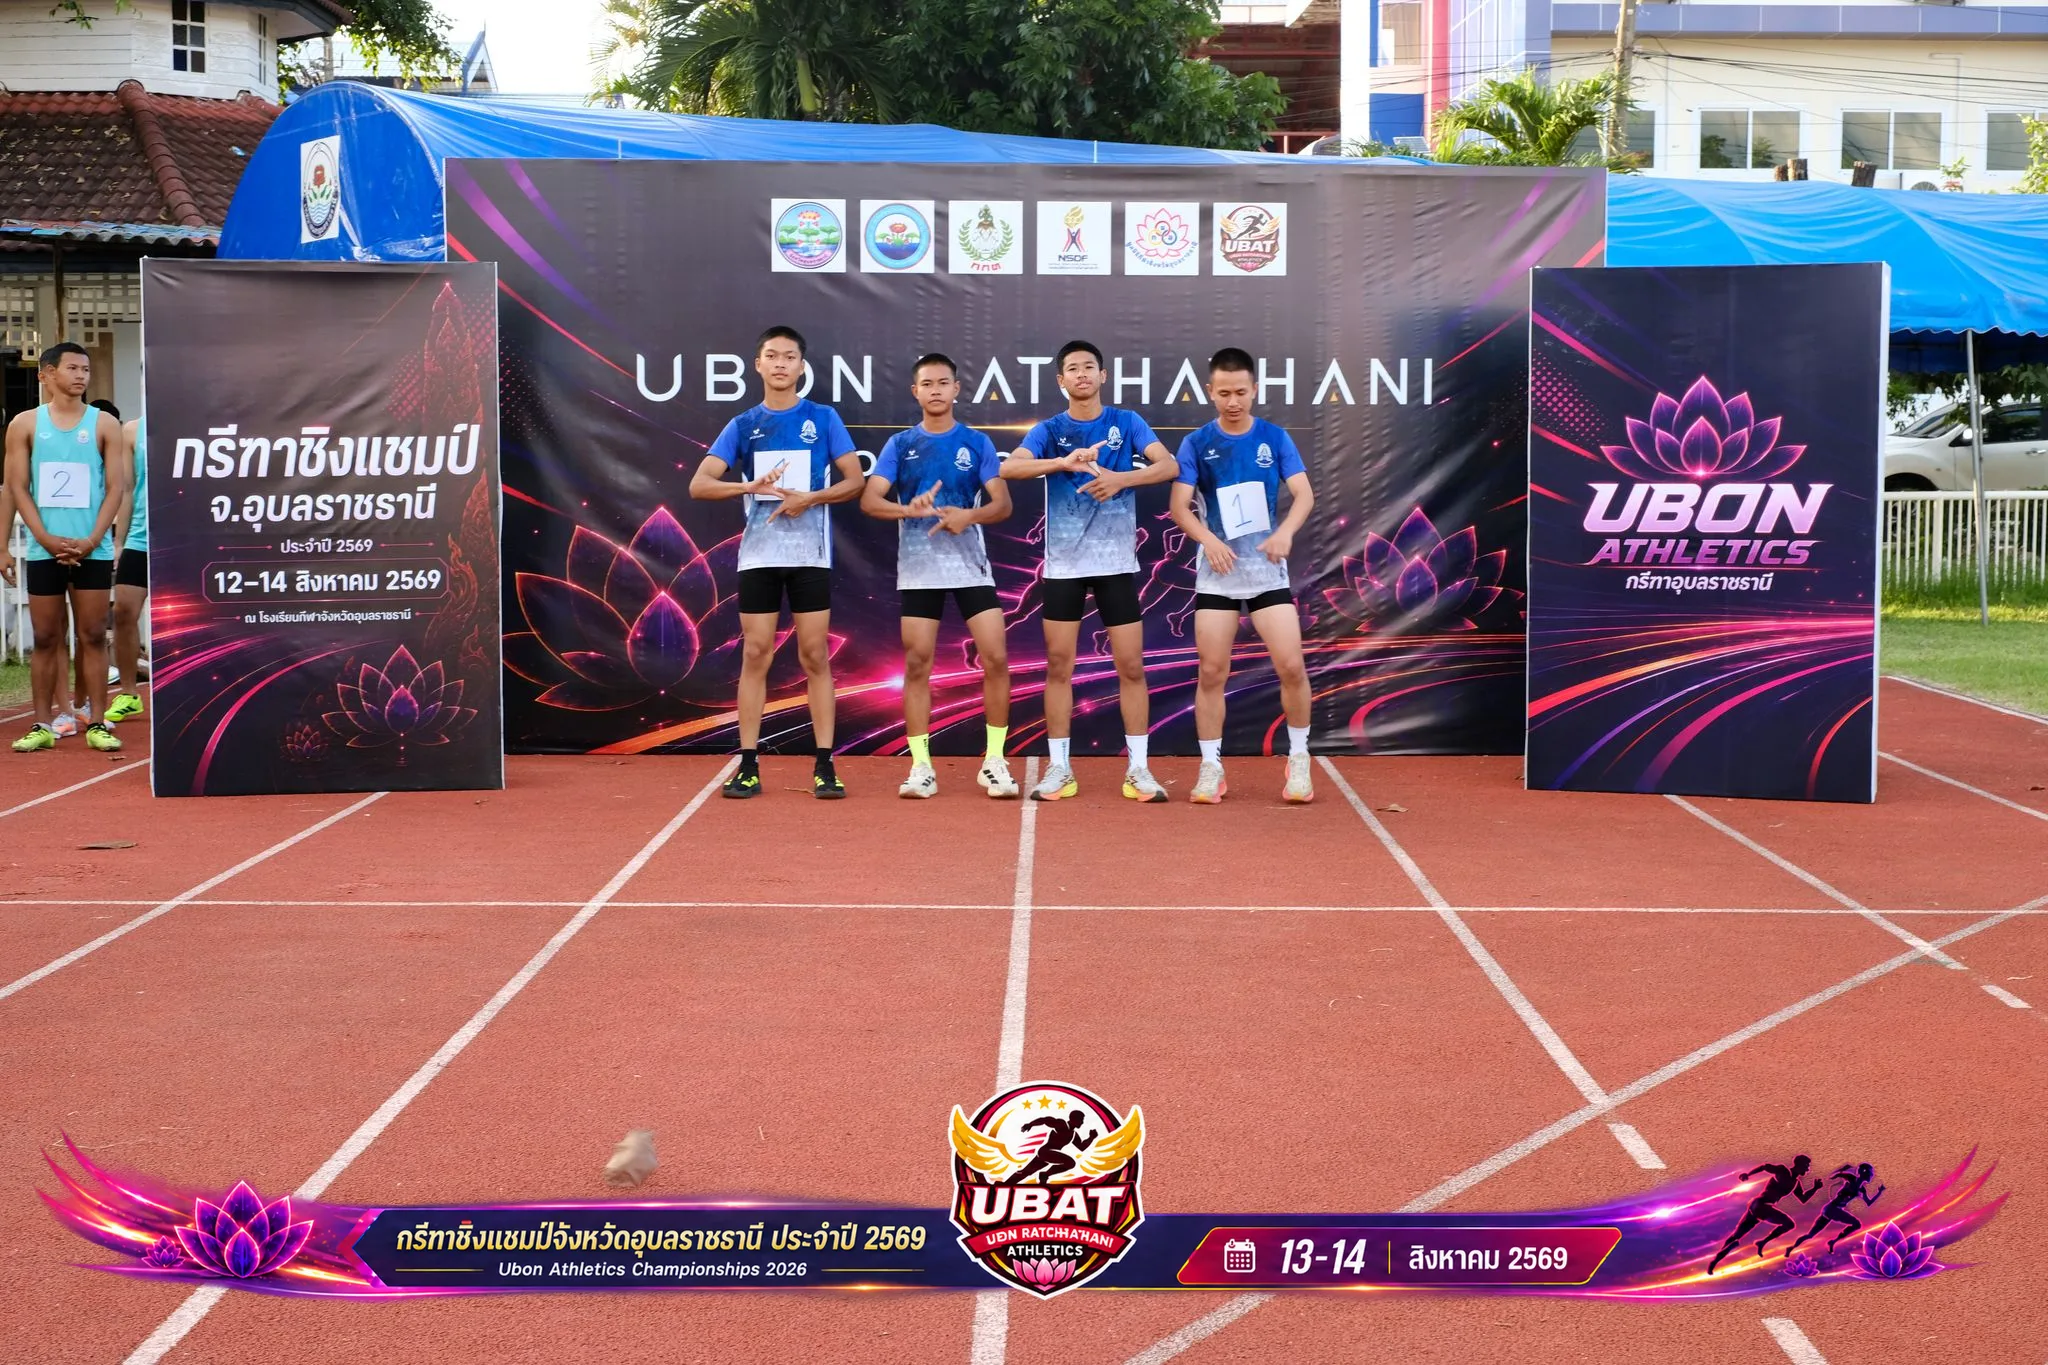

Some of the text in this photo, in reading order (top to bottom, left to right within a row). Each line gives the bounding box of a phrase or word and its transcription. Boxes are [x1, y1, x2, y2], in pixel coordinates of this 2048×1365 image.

[1058, 254, 1088, 262] NSDF
[1225, 239, 1276, 253] UBAT
[636, 353, 1433, 405] UBN ATHAHANI
[51, 470, 73, 498] 2
[1232, 493, 1252, 528] 1
[1583, 483, 1835, 534] UBON
[280, 537, 374, 554] ประจำปี 2569
[1582, 538, 1823, 565] ATHLETICS
[295, 569, 378, 593] สิงหาคม
[385, 569, 442, 591] 2569
